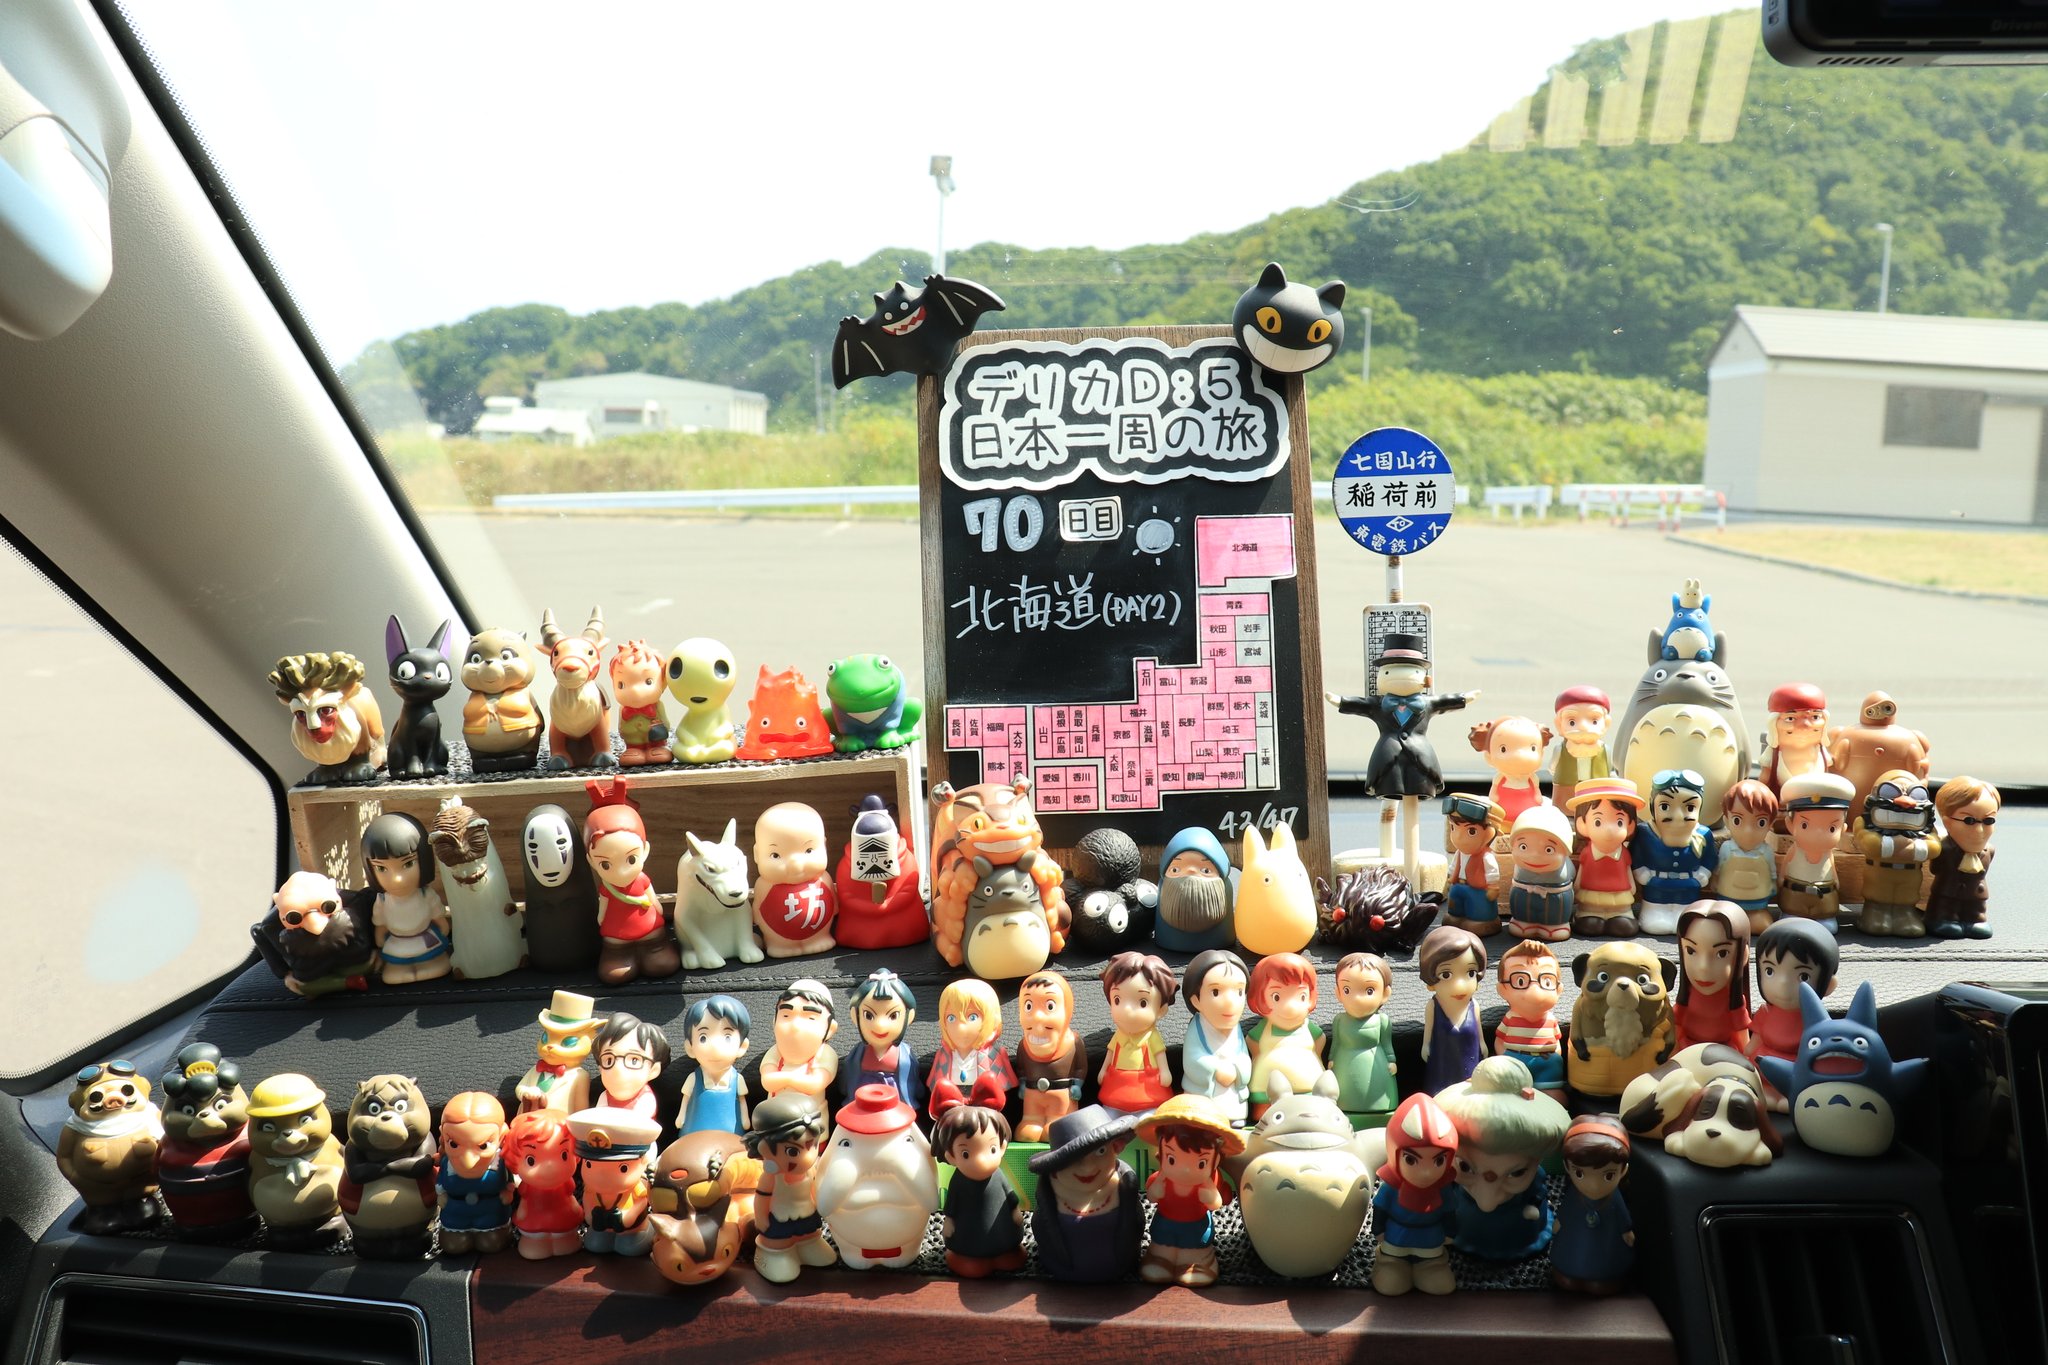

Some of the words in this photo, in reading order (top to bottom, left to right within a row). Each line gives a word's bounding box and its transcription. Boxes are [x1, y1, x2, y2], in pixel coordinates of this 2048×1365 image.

[968, 404, 1262, 465] 日本一周の旅
[1349, 450, 1437, 471] 七国山行
[1346, 480, 1437, 508] 稲荷前
[962, 494, 1044, 553] 70
[1066, 506, 1117, 534] 日目
[1353, 521, 1444, 553] 東電鉄バス
[1231, 543, 1258, 552] 北海道
[1226, 601, 1243, 609] 青森
[1209, 625, 1227, 633] 秋田
[1243, 624, 1261, 633] 岩手
[1209, 648, 1227, 657] 山形
[1243, 647, 1262, 656] 宮城
[1142, 669, 1151, 686] 石川
[1159, 677, 1176, 686] 富山
[1190, 676, 1207, 686] 新潟
[1234, 676, 1252, 685] 福島
[1207, 702, 1225, 711] 群馬
[1233, 702, 1251, 711] 栃木
[1259, 702, 1268, 718] 茨城
[1130, 708, 1147, 717] 福井
[1056, 710, 1066, 727] 島根
[1074, 710, 1083, 727] 鳥取
[1178, 718, 1196, 727] 長野
[952, 719, 961, 736] 長崎
[970, 719, 979, 736] 佐賀
[987, 723, 1004, 732] 福岡
[1160, 721, 1170, 738] 岐阜
[1222, 725, 1239, 734] 埼玉
[1039, 727, 1048, 743] 山口
[1091, 725, 1101, 742] 兵庫
[1113, 731, 1131, 740] 京都
[1143, 726, 1153, 743] 滋賀
[1013, 731, 1023, 748] 大分
[1056, 736, 1066, 753] 広島
[1074, 736, 1084, 753] 岡山
[1196, 748, 1213, 757] 山梨
[1223, 748, 1240, 756] 東京
[1261, 749, 1270, 766] 千葉
[987, 762, 1005, 771] 熊本
[1110, 755, 1119, 771] 大阪
[1127, 761, 1136, 778] 奈良
[1042, 774, 1060, 782] 愛媛
[1073, 772, 1090, 781] 香川
[1145, 769, 1154, 786] 三重
[1162, 773, 1180, 782] 愛知
[1187, 772, 1205, 781] 静岡
[1220, 771, 1244, 780] 神奈川
[1043, 796, 1060, 804] 高知
[1073, 795, 1091, 804] 徳島
[1111, 794, 1137, 802] 和歌山
[1218, 802, 1299, 839] 42/47
[784, 883, 826, 929] 坊
